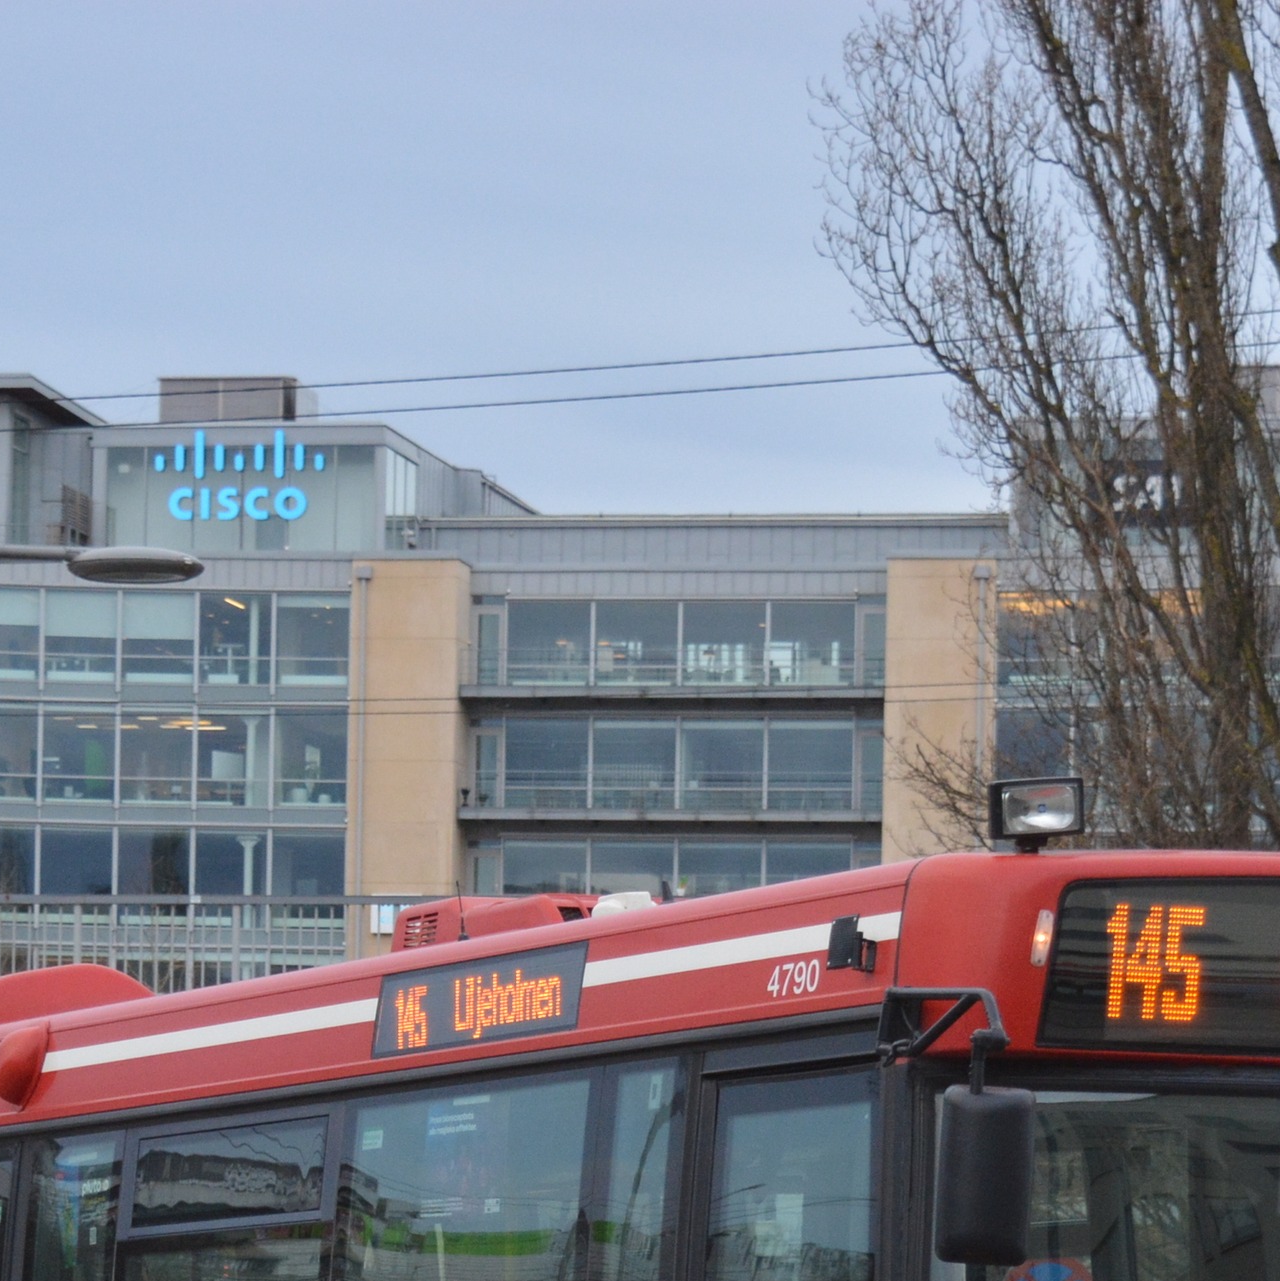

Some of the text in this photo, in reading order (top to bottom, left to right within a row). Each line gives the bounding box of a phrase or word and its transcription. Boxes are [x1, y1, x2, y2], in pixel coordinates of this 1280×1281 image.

[168, 486, 308, 521] CISCO
[767, 958, 821, 998] 4790
[1105, 903, 1206, 1021] 145
[394, 968, 561, 1050] 145 Liljeholmen
